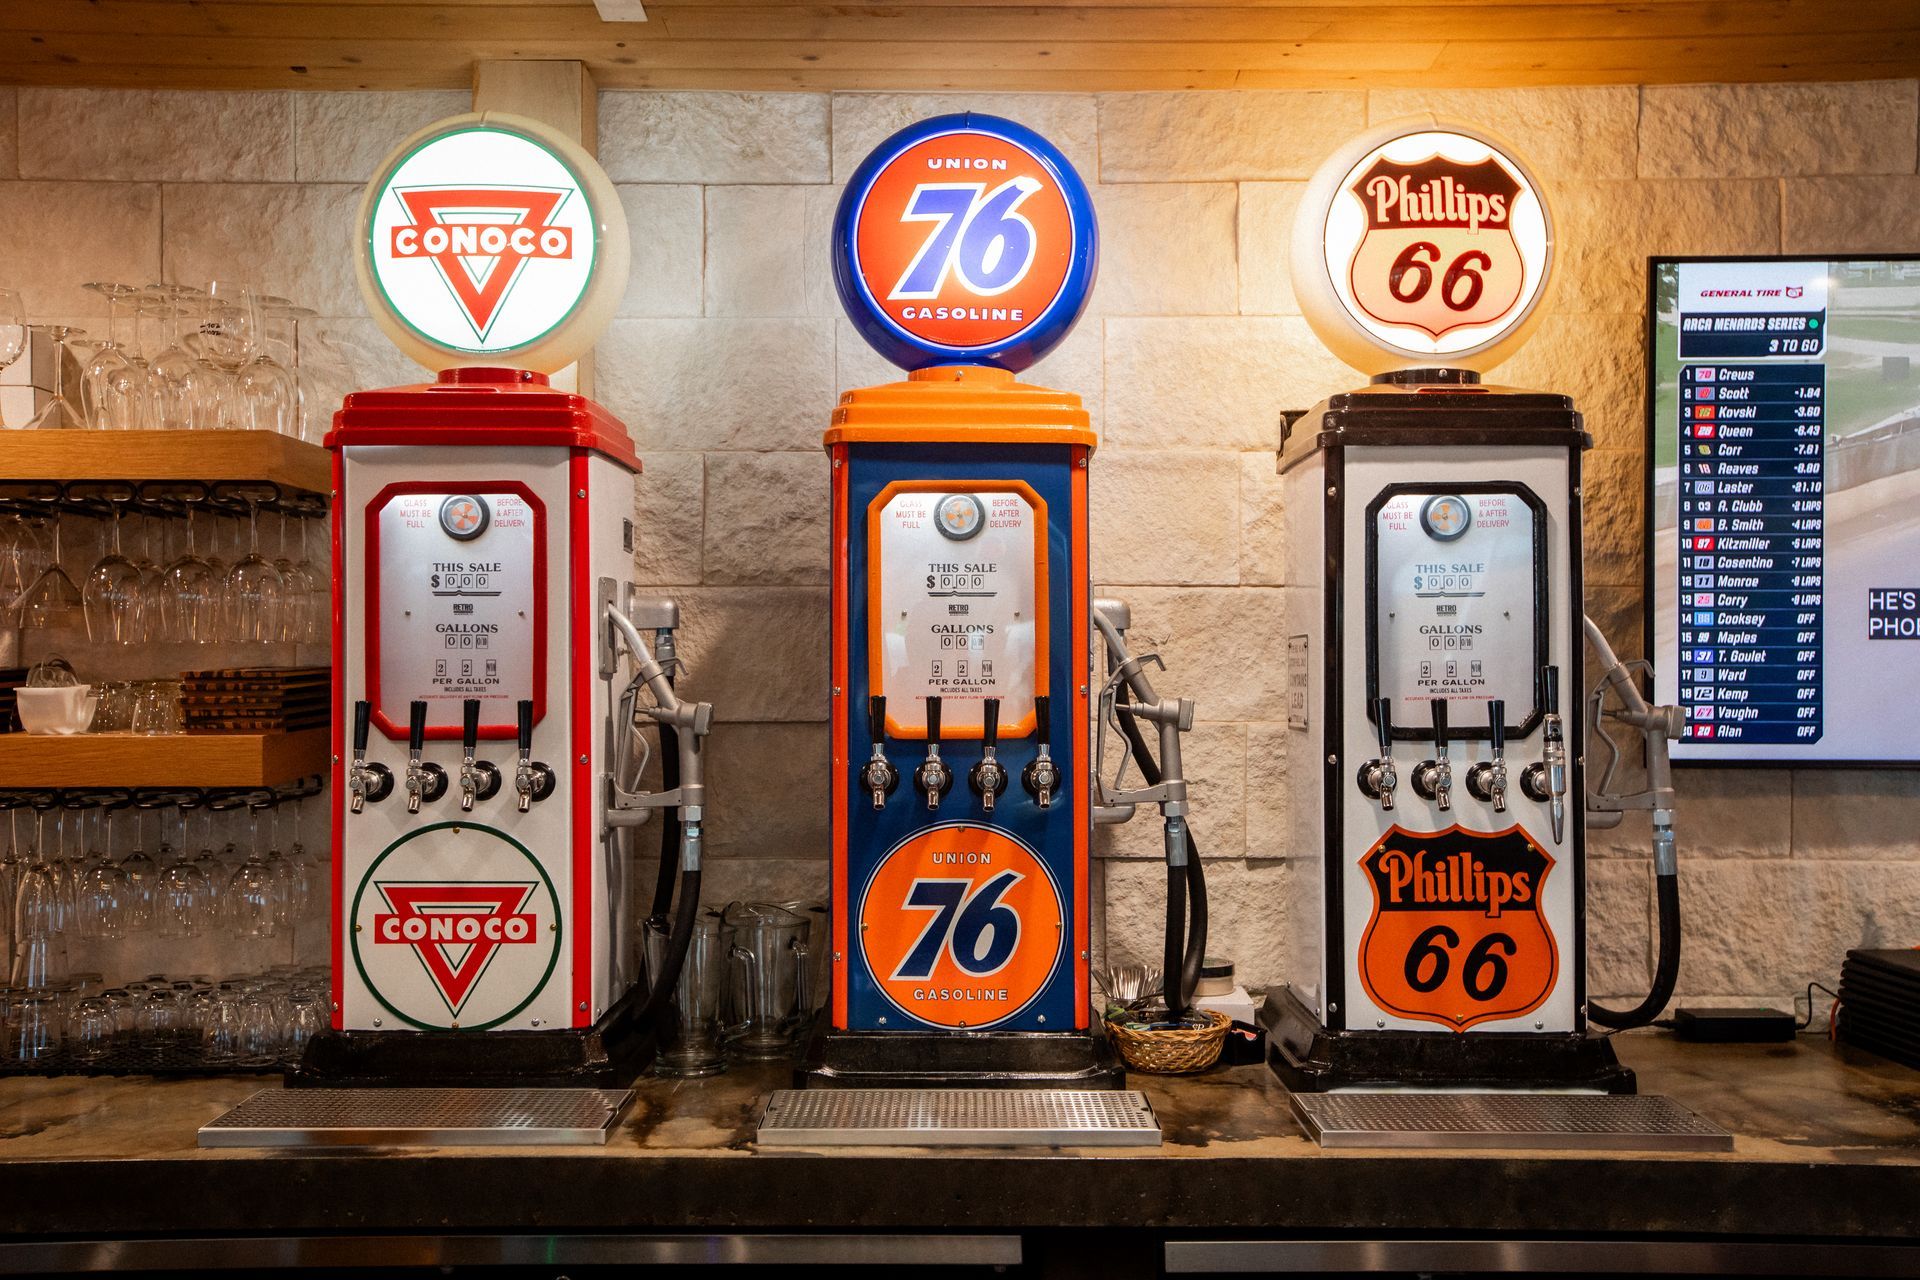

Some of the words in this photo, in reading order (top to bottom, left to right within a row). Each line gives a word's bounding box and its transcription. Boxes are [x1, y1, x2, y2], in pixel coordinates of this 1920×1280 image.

[927, 157, 1008, 171] UNION
[1366, 174, 1507, 235] Phillips
[395, 226, 568, 256] CONOCO
[887, 176, 1043, 301] 76
[1388, 241, 1492, 312] 66
[1756, 289, 1782, 297] TIRE
[902, 306, 1024, 322] GASOLINE
[1683, 318, 1713, 331] ARCA
[1714, 318, 1765, 331] MENARDS
[1767, 317, 1806, 331] SERIES
[1769, 340, 1779, 352] 3
[1783, 339, 1798, 352] TO
[1801, 339, 1819, 352] GO
[1685, 369, 1691, 380] 1
[1719, 369, 1755, 381] Crews
[1684, 388, 1692, 399] 2
[1719, 387, 1750, 400] Scott
[1794, 388, 1821, 399] -1.84
[1684, 407, 1691, 418] 3
[1718, 406, 1757, 418] Kovski
[1684, 426, 1691, 437] 4
[1718, 424, 1753, 439] Queen
[1684, 444, 1691, 455] 5
[1718, 443, 1743, 456] Corr
[1684, 463, 1691, 474] 6
[1718, 462, 1759, 475] Reaves
[1684, 482, 1691, 493] 7
[1718, 481, 1754, 493] Laster
[1792, 481, 1822, 493] -21.10
[404, 499, 427, 507] GLASS
[497, 498, 523, 506] BEFORE
[992, 499, 1018, 507] BEFORE
[1386, 501, 1409, 509] GLASS
[1479, 498, 1506, 507] BEFORE
[1684, 501, 1691, 512] 8
[1698, 501, 1711, 511] 03
[1731, 499, 1763, 512] Clubb
[1802, 501, 1822, 511] LAPS
[400, 509, 420, 518] MUST
[421, 509, 432, 518] BE
[502, 509, 524, 517] AFTER
[896, 510, 915, 518] MUST
[917, 510, 927, 518] BE
[998, 510, 1020, 518] AFTER
[1382, 512, 1402, 520] MUST
[1403, 511, 1414, 520] BE
[1485, 509, 1508, 517] AFTER
[406, 520, 425, 529] FULL
[494, 519, 526, 528] DELIVERY
[902, 521, 920, 529] FULL
[989, 520, 1022, 528] DELIVERY
[1389, 522, 1407, 530] FULL
[1476, 519, 1510, 528] DELIVERY
[1683, 519, 1690, 530] 9
[1718, 519, 1728, 531] B.
[1731, 518, 1764, 531] Smith
[1801, 519, 1822, 530] LAPS
[1682, 538, 1692, 549] 10
[1718, 537, 1771, 550] Kitzmiller
[1801, 538, 1822, 549] LAPS
[432, 563, 464, 572] THIS
[469, 563, 502, 572] SALE
[928, 563, 959, 573] THIS
[964, 563, 997, 573] SALE
[1415, 564, 1446, 573] THIS
[1451, 563, 1485, 573] SALE
[1682, 557, 1691, 568] 11
[1718, 556, 1774, 569] Cosentino
[1801, 557, 1822, 567] LAPS
[1682, 576, 1692, 587] 12
[1718, 575, 1759, 587] Monroe
[1801, 576, 1821, 587] LAPS
[1682, 594, 1692, 605] 13
[1718, 593, 1748, 608] Corry
[1801, 595, 1821, 605] LAPS
[1870, 590, 1916, 610] HE'S
[453, 603, 473, 611] RETRO
[1436, 604, 1457, 612] RETRO
[1682, 613, 1692, 624] 14
[1718, 612, 1765, 628] Cooksey
[1797, 613, 1816, 624] OFF
[435, 623, 498, 633] GALLONS
[931, 624, 994, 634] GALLONS
[1419, 624, 1483, 634] GALLONS
[1718, 631, 1757, 646] Maples
[1797, 632, 1816, 643] OFF
[1697, 651, 1711, 661] 31
[1718, 650, 1727, 662] T.
[1730, 650, 1766, 663] Goulet
[1797, 651, 1816, 662] OFF
[1682, 669, 1691, 680] 17
[1700, 670, 1707, 680] 9
[1718, 668, 1747, 681] Ward
[1797, 670, 1816, 681] OFF
[1292, 692, 1304, 709] LEAD
[1682, 688, 1692, 699] 18
[1696, 689, 1712, 698] 12
[1718, 687, 1749, 703] Kemp
[1797, 689, 1816, 699] OFF
[1718, 706, 1759, 721] Vaughn
[1797, 707, 1816, 718] OFF
[1718, 725, 1742, 737] Alan
[1797, 726, 1816, 737] OFF
[932, 852, 993, 864] UNION
[1378, 849, 1532, 918] Phillips
[382, 917, 529, 941] CONOCO
[888, 868, 1026, 981] 76
[1404, 925, 1518, 1002] 66
[913, 988, 1009, 1001] GASOLINE
